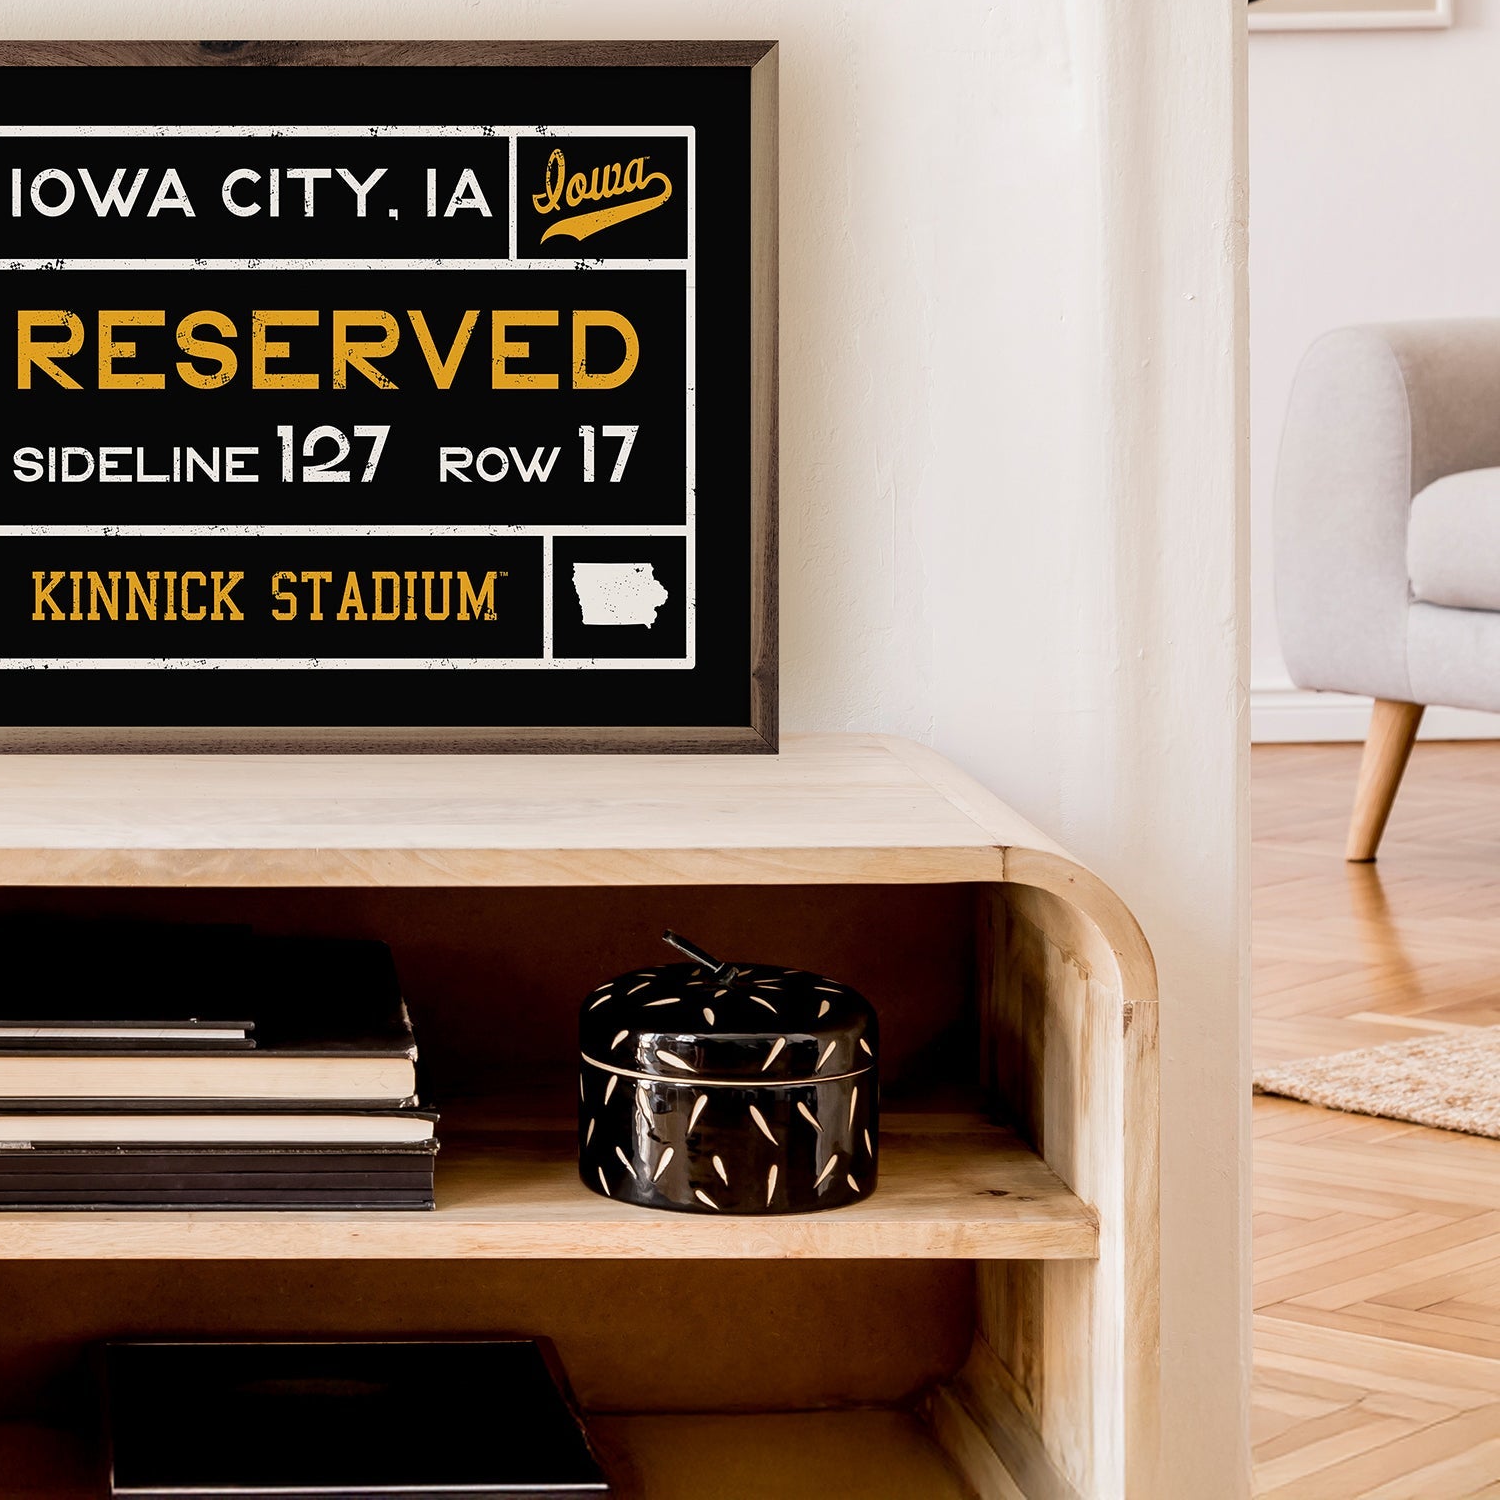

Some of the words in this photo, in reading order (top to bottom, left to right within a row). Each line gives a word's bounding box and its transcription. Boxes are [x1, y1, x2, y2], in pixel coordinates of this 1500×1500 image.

[12, 168, 196, 217] IOWA
[222, 168, 398, 220] CITY,
[427, 169, 492, 217] IA
[533, 149, 650, 214] Iowa
[18, 310, 639, 389] RESERVED
[14, 447, 258, 482] SIDELINE
[277, 425, 390, 482] 127
[440, 447, 561, 482] ROW
[579, 425, 639, 482] 17
[32, 572, 244, 620] KINNICK
[272, 572, 497, 620] STADIUM
